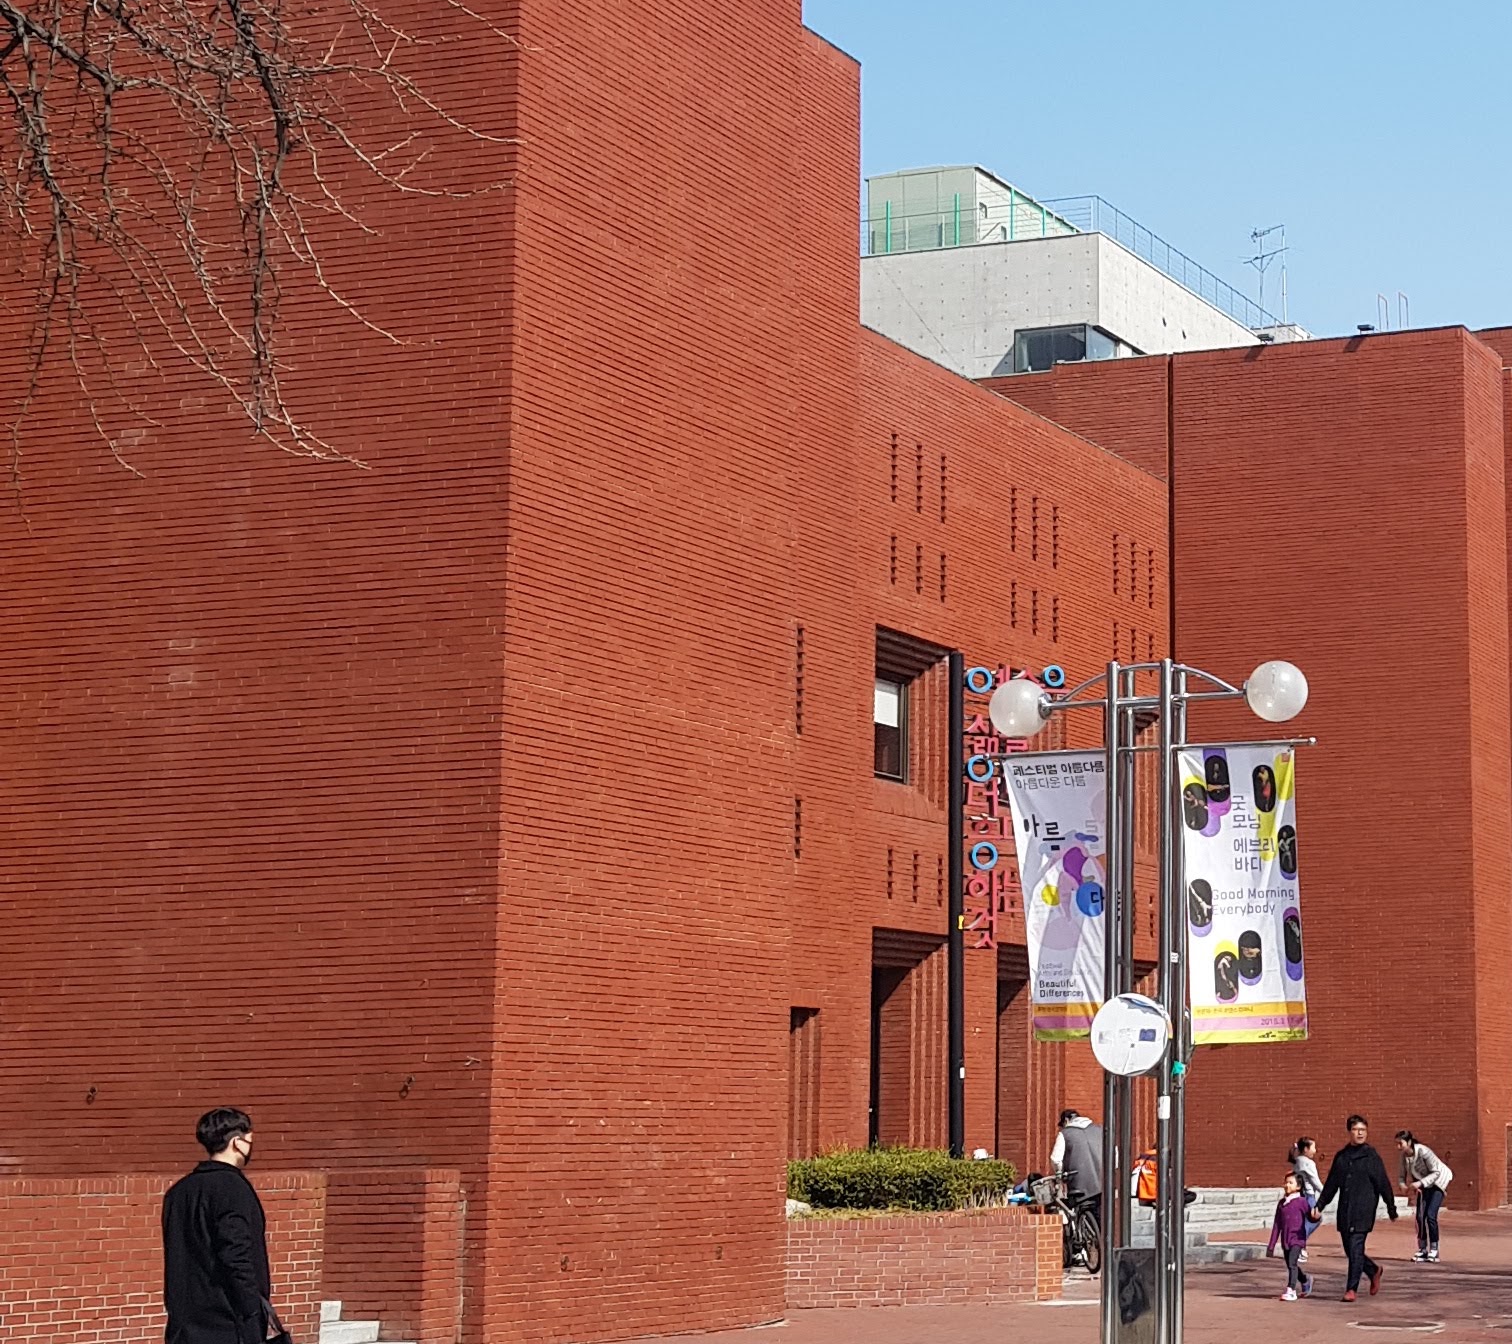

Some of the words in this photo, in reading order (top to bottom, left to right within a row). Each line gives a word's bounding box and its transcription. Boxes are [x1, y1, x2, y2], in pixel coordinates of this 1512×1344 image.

[1232, 814, 1262, 829] 모닝
[1233, 837, 1275, 853] 에브리
[1234, 856, 1262, 872] 바디
[1212, 888, 1244, 900] Good
[1247, 886, 1295, 901] Morning
[1212, 901, 1276, 916] Everybody
[1039, 979, 1077, 989] Beautiful
[1039, 989, 1084, 998] Differences
